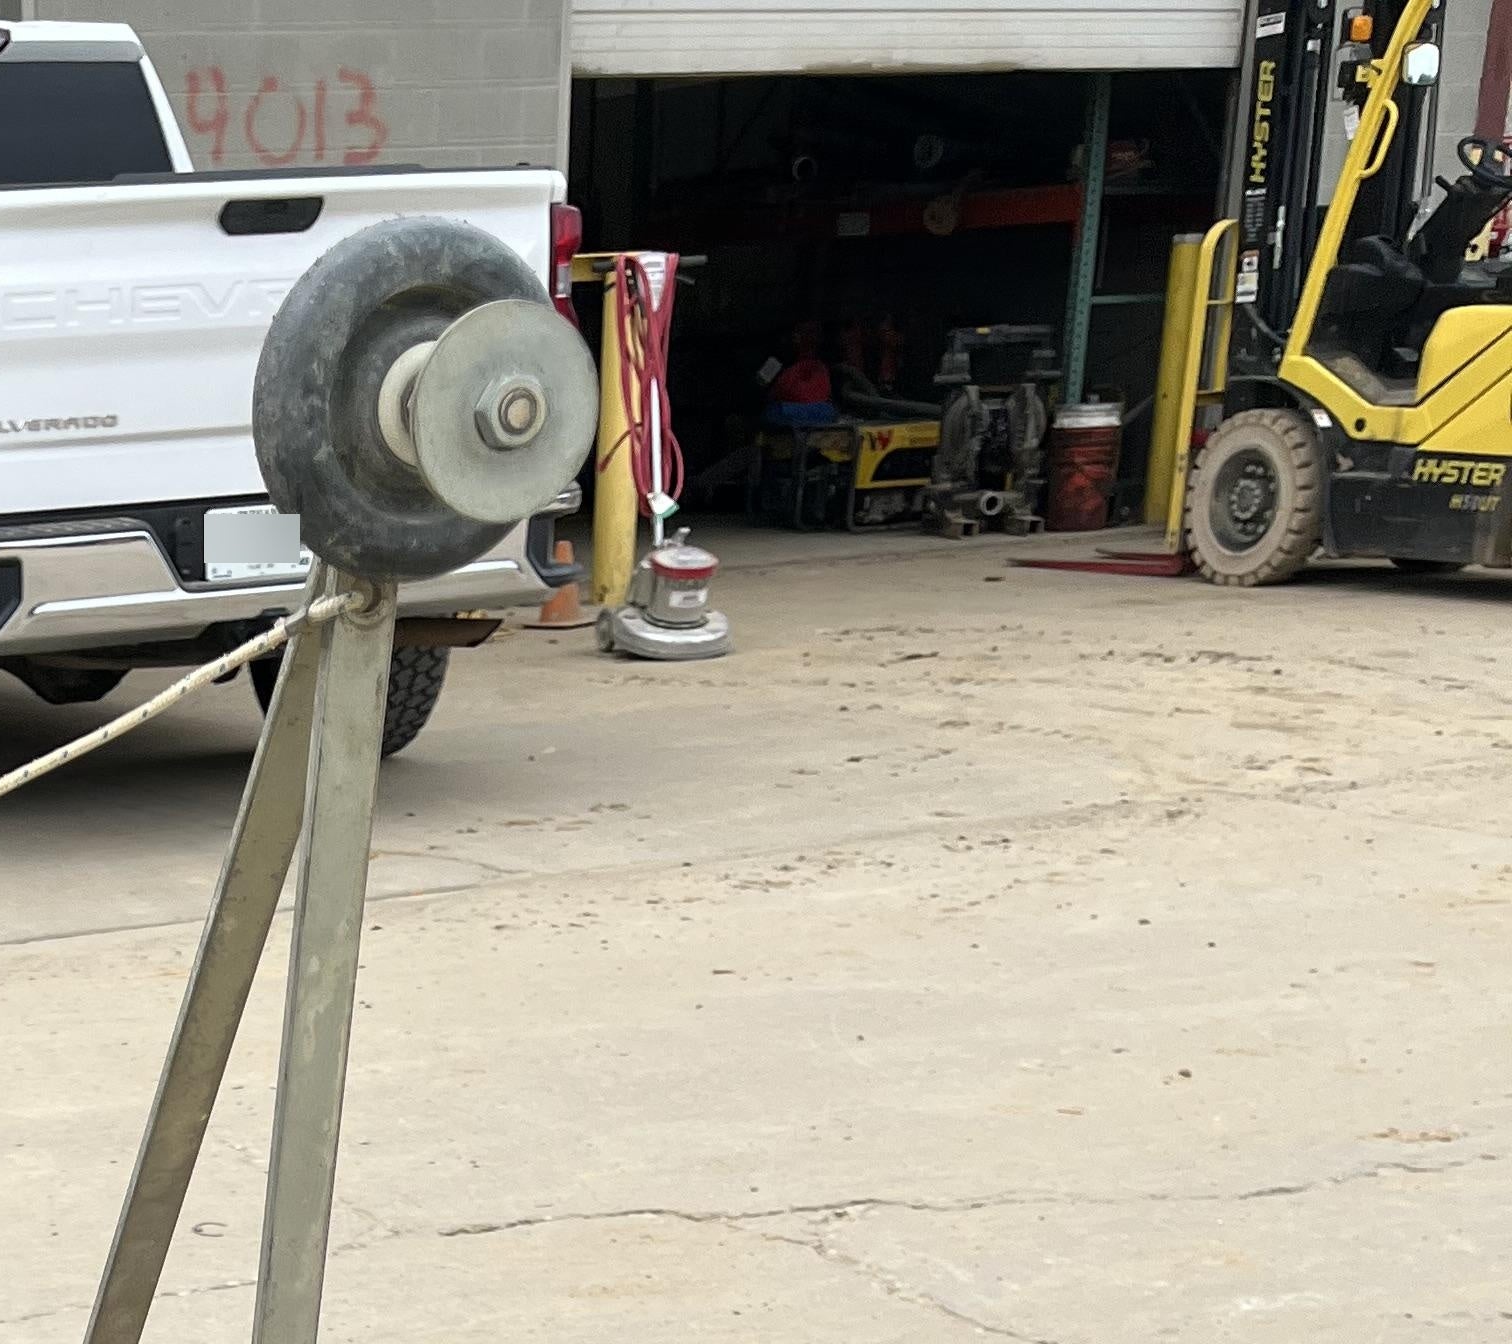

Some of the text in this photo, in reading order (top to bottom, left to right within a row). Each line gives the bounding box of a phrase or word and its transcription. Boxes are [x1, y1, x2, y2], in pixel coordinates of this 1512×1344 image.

[184, 65, 388, 165] 4013
[1249, 60, 1276, 183] HYSTER
[1412, 459, 1507, 487] HYSTER
